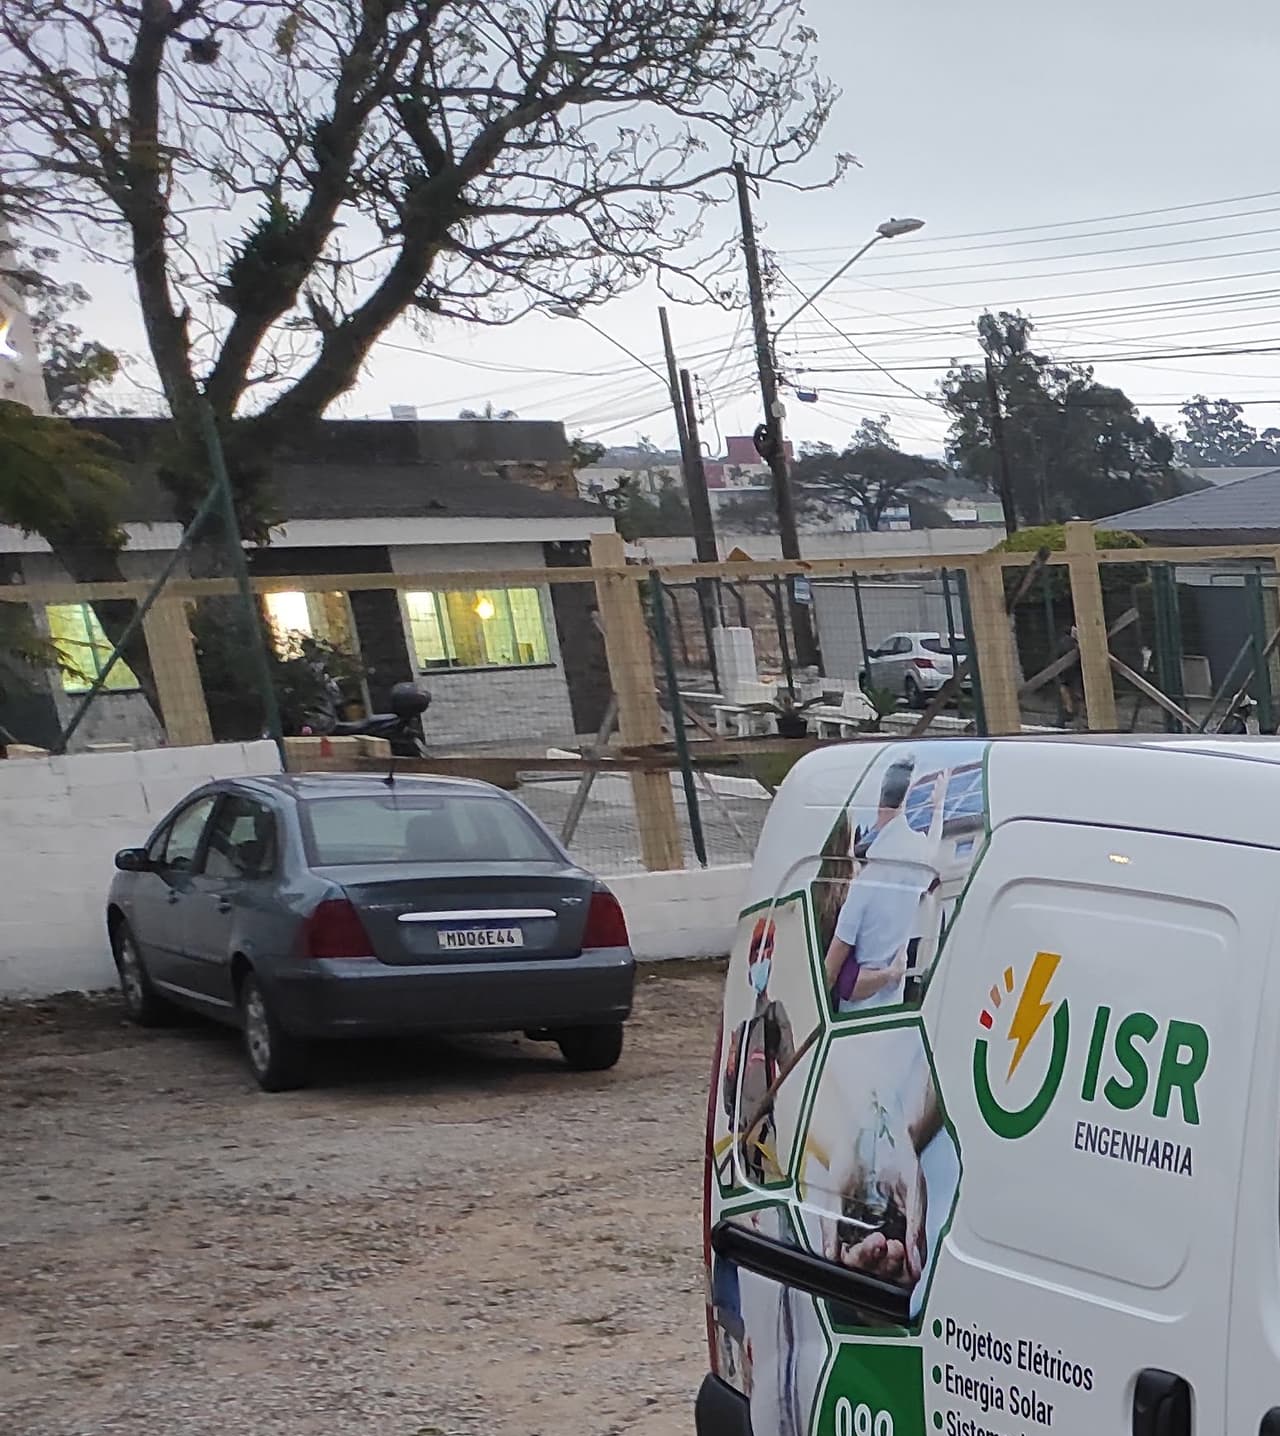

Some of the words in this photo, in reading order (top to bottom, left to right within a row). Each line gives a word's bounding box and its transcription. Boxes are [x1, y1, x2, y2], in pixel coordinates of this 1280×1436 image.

[1081, 1006, 1209, 1125] ISR
[1074, 1121, 1193, 1177] ENGENHARIA
[945, 1318, 1012, 1366] Projetos
[1017, 1339, 1094, 1391] Elétricos
[945, 1364, 1004, 1412] Energia
[1009, 1386, 1054, 1426] Solar
